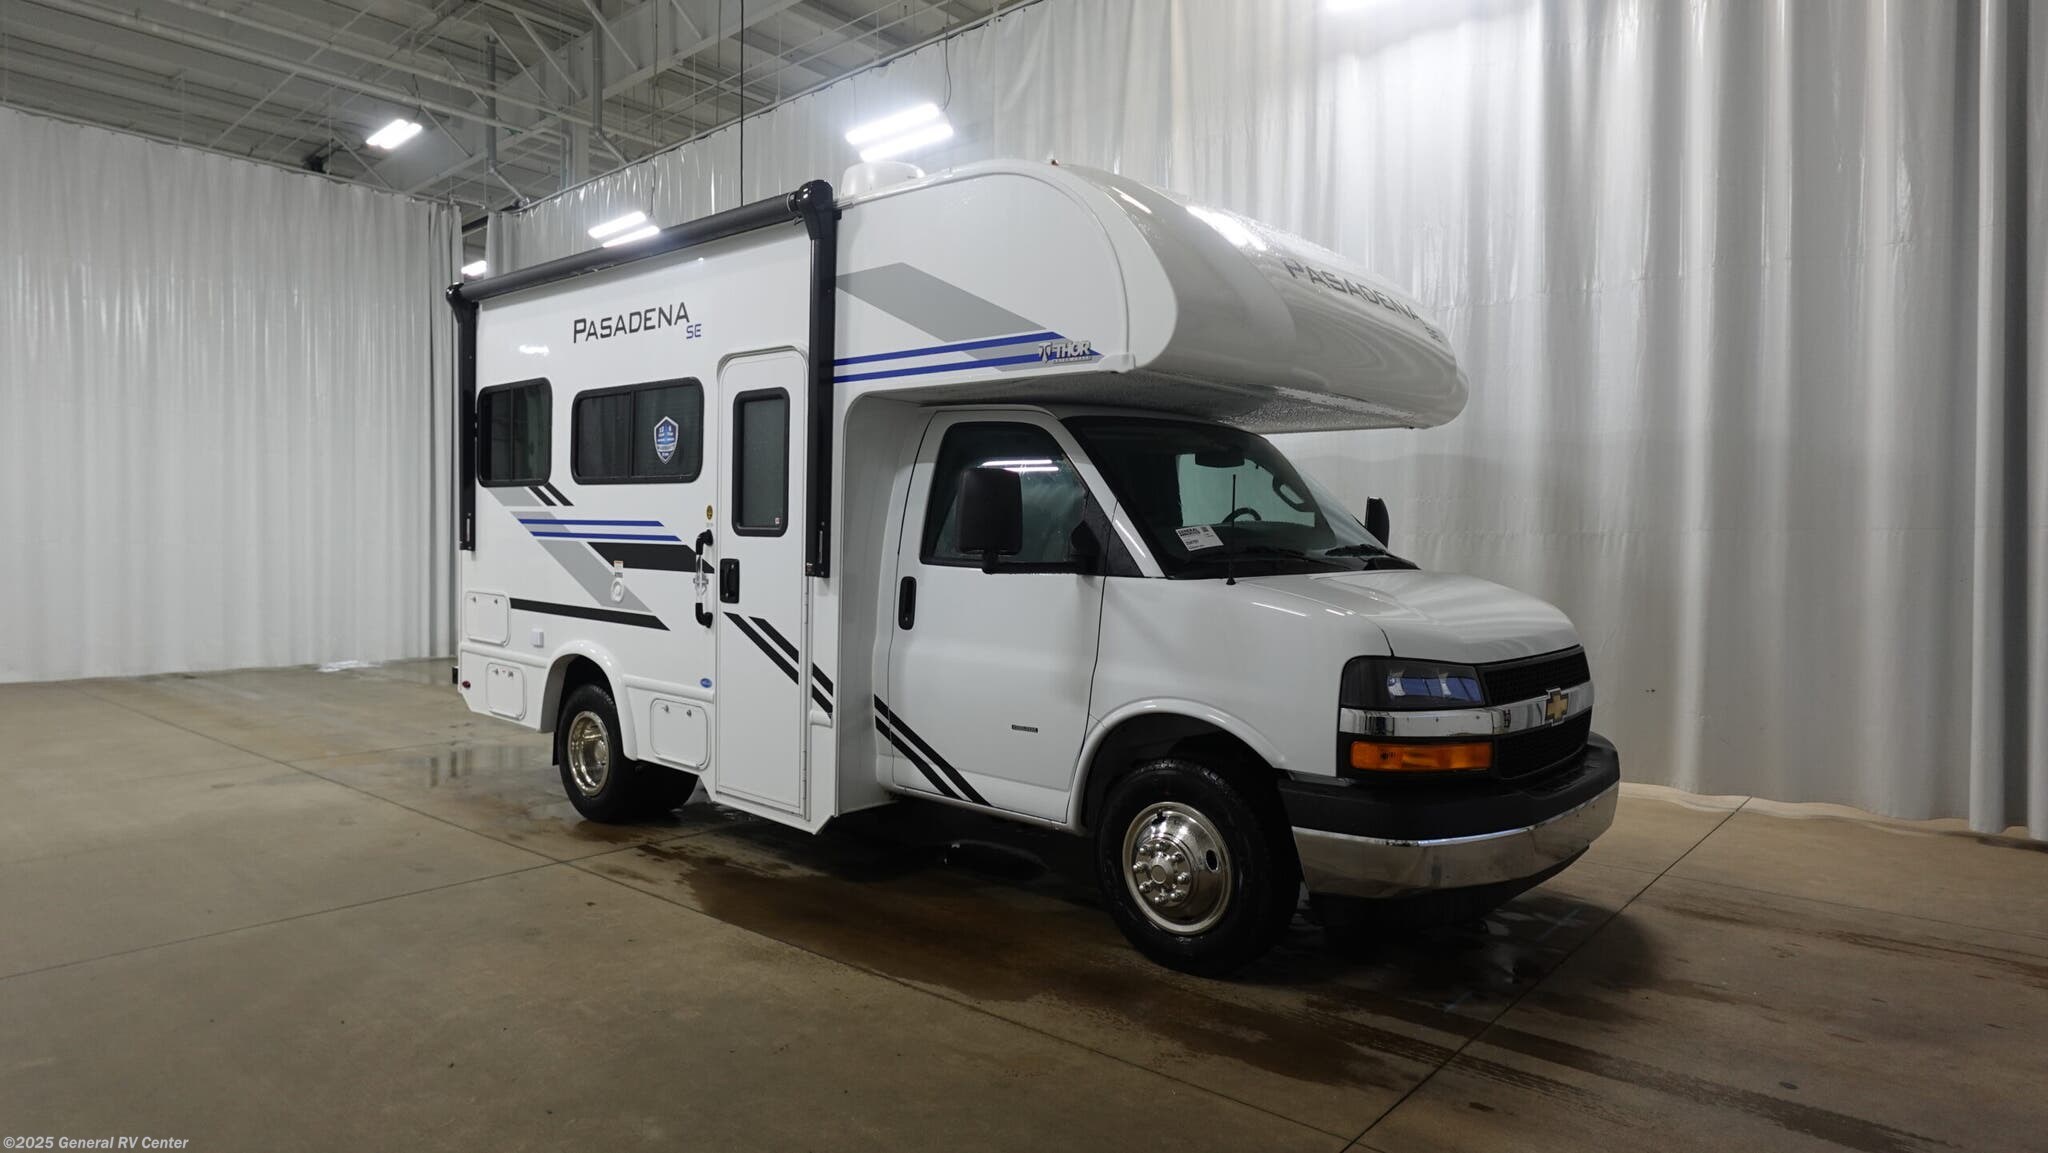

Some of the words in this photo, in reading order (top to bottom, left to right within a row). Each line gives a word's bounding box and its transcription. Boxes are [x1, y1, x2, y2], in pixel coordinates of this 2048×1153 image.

[1282, 257, 1420, 321] PASADENA
[573, 301, 690, 344] PASADENA
[686, 323, 702, 339] SE
[1053, 340, 1091, 358] THOR
